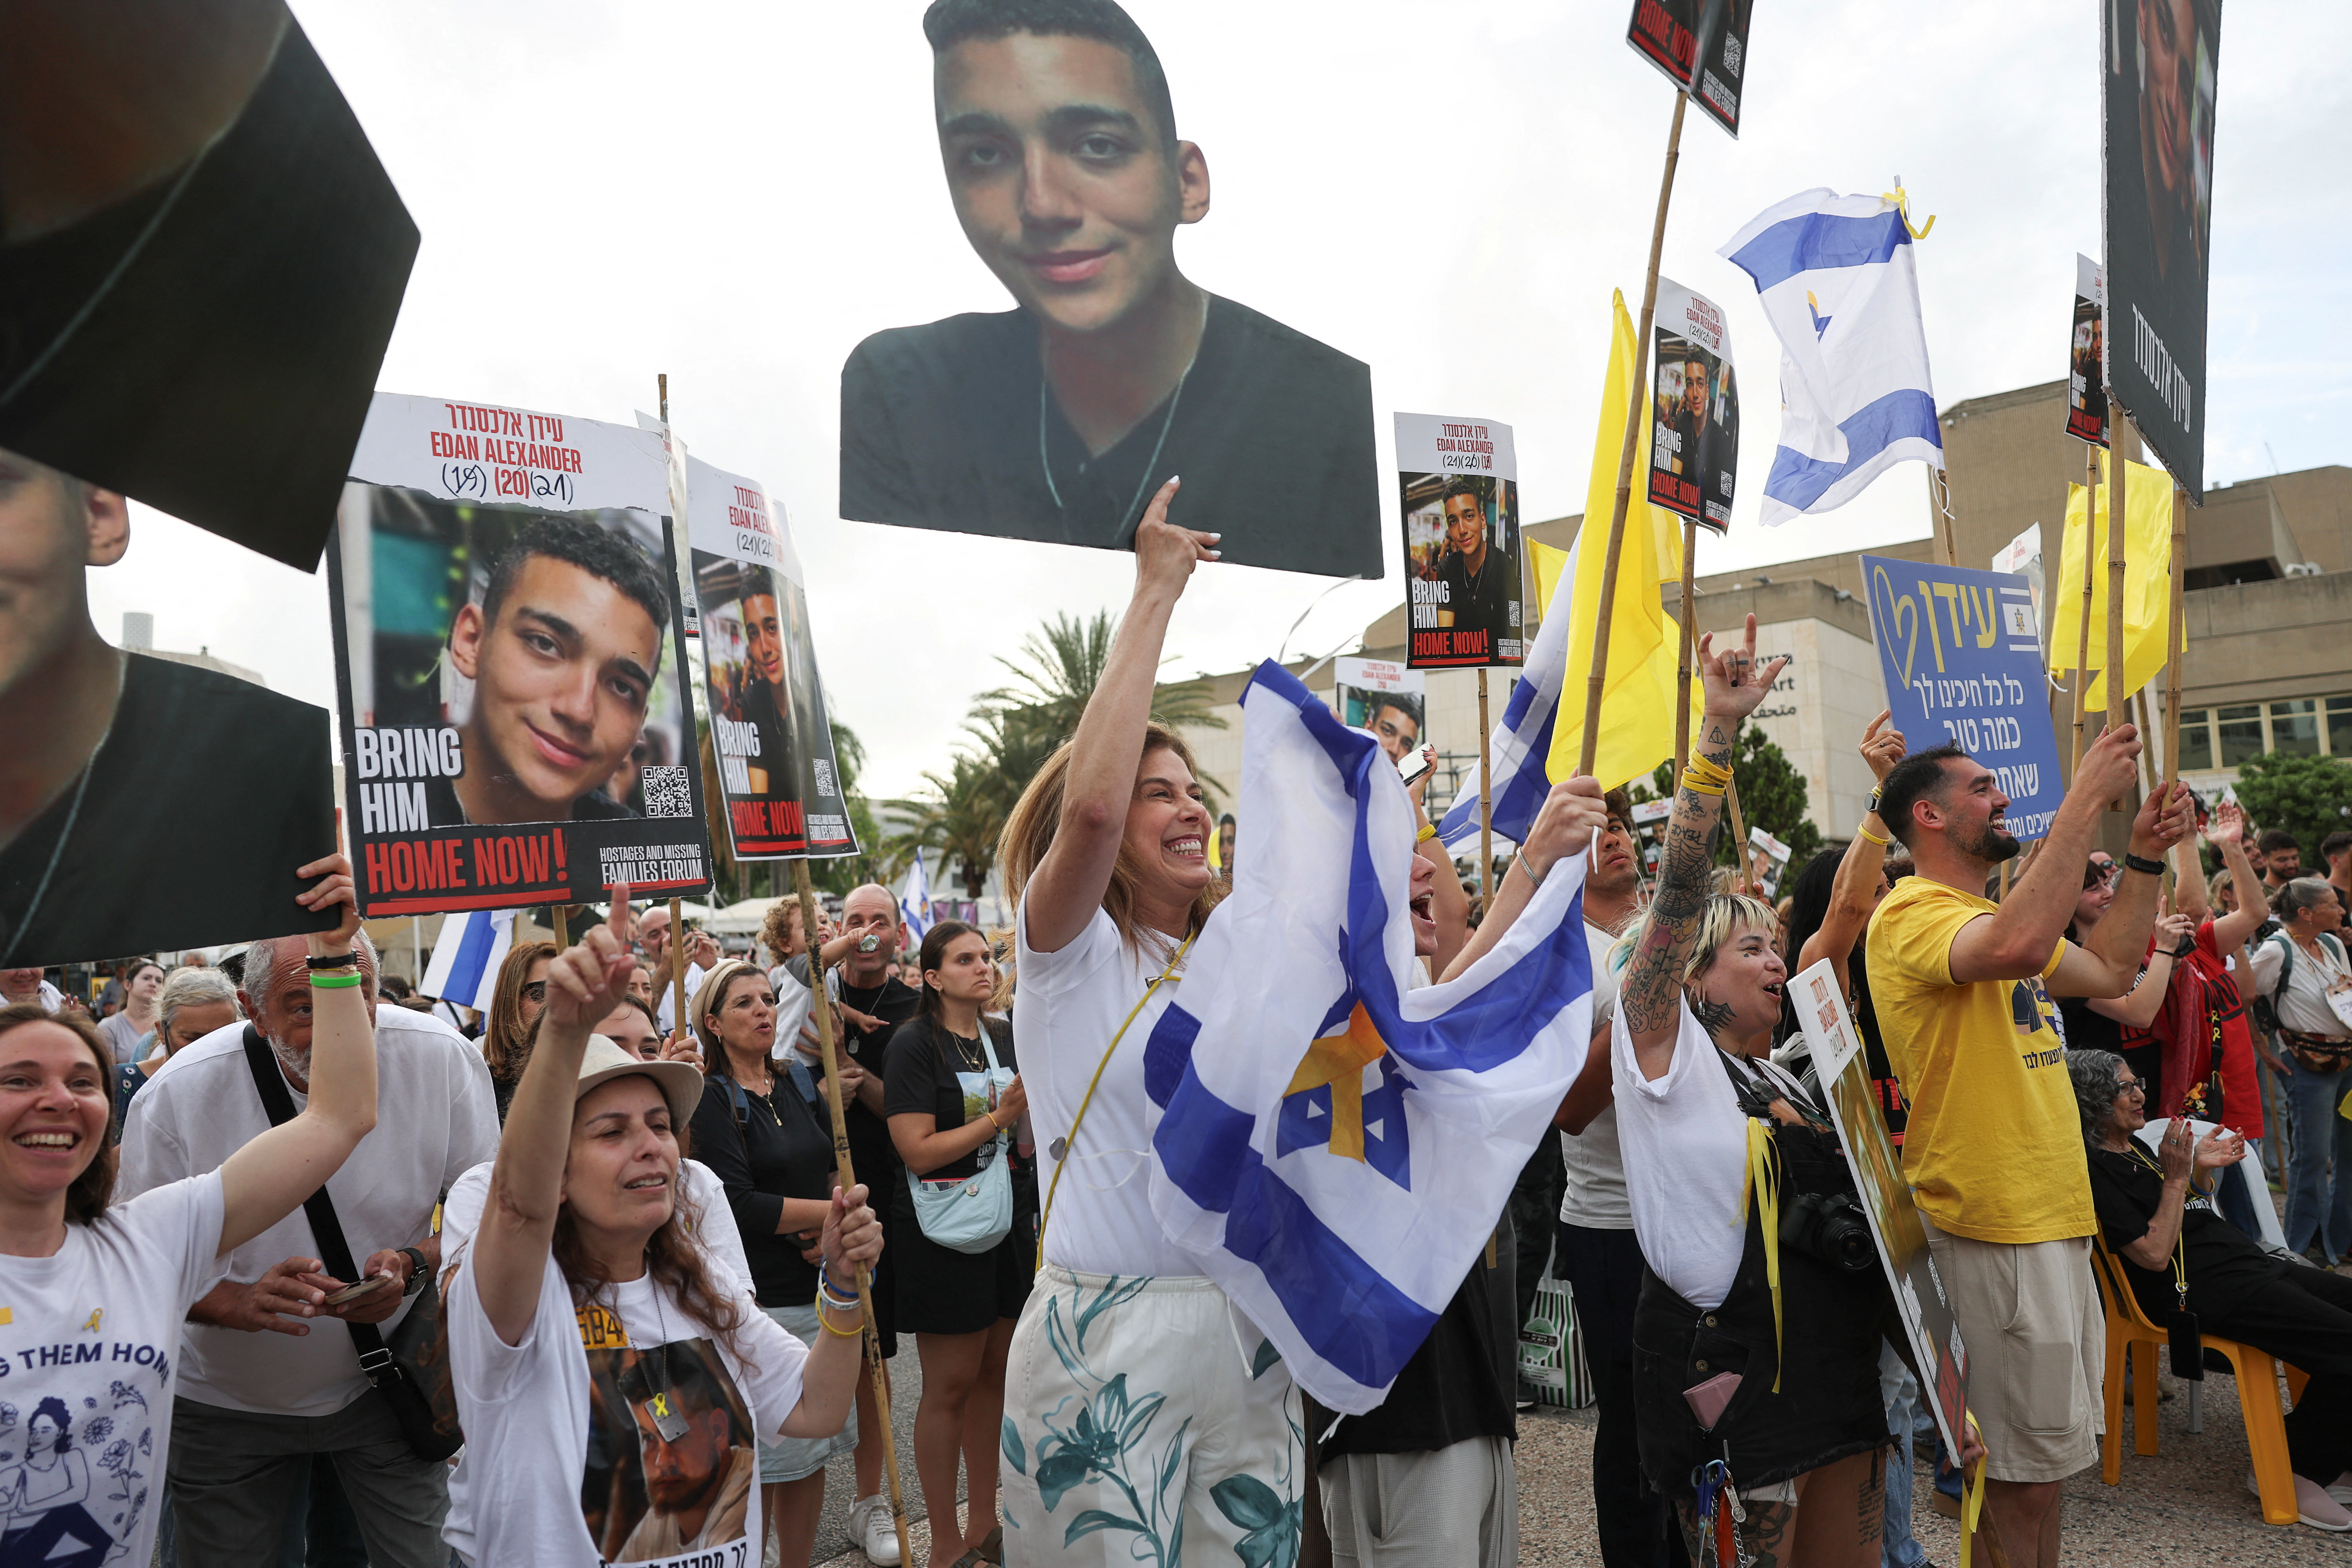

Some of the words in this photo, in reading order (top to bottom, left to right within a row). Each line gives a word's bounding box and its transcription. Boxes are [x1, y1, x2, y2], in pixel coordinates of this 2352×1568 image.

[1637, 0, 1673, 48] HOME
[1687, 308, 1699, 324] EDAN
[1700, 315, 1722, 339] ALEXANDER
[2132, 303, 2172, 409] אלכסנדר
[2072, 371, 2086, 393] BRING
[2174, 363, 2190, 433] עידן
[445, 403, 524, 437] אלכסנדר
[528, 414, 564, 443] עידן
[1442, 424, 1473, 438] אלכסנדר
[1475, 426, 1488, 439] עידן
[430, 431, 479, 461] EDAN
[485, 437, 583, 474] ALEXANDER
[1437, 438, 1455, 452] EDAN
[1458, 440, 1494, 455] ALEXANDER
[1656, 425, 1682, 453] BRING
[1654, 446, 1672, 472] HIM
[1653, 471, 1678, 499] HOME
[729, 506, 751, 529] EDAN
[1706, 506, 1721, 521] FAMILIES
[1412, 581, 1450, 604] BRING
[1414, 606, 1437, 628] HIM
[1918, 581, 1996, 673] עידן
[1414, 632, 1450, 655] HOME
[1453, 628, 1488, 654] NOW!
[1499, 646, 1513, 657] FAMILIES
[1769, 677, 1794, 691] Art
[1913, 673, 1934, 719] לך
[1938, 680, 1983, 708] חיכינו
[1982, 673, 2003, 706] כל
[2003, 673, 2024, 705] כל
[716, 719, 760, 757] BRING
[1982, 717, 2021, 751] כמה
[354, 727, 463, 779] BRING
[722, 758, 751, 794] HIM
[360, 782, 428, 834] HIM
[730, 801, 769, 836] HOME
[1671, 824, 1702, 845] PEACE
[365, 839, 466, 894] HOME
[474, 828, 568, 886] NOW!
[599, 846, 644, 862] HOSTAGES
[646, 846, 663, 860] AND
[664, 844, 701, 858] MISSING
[601, 862, 658, 884] FAMILIES
[661, 858, 704, 882] FORUM
[2022, 1051, 2038, 1069] לבד
[1849, 1204, 1866, 1215] Canon
[17, 1342, 103, 1369] THEM
